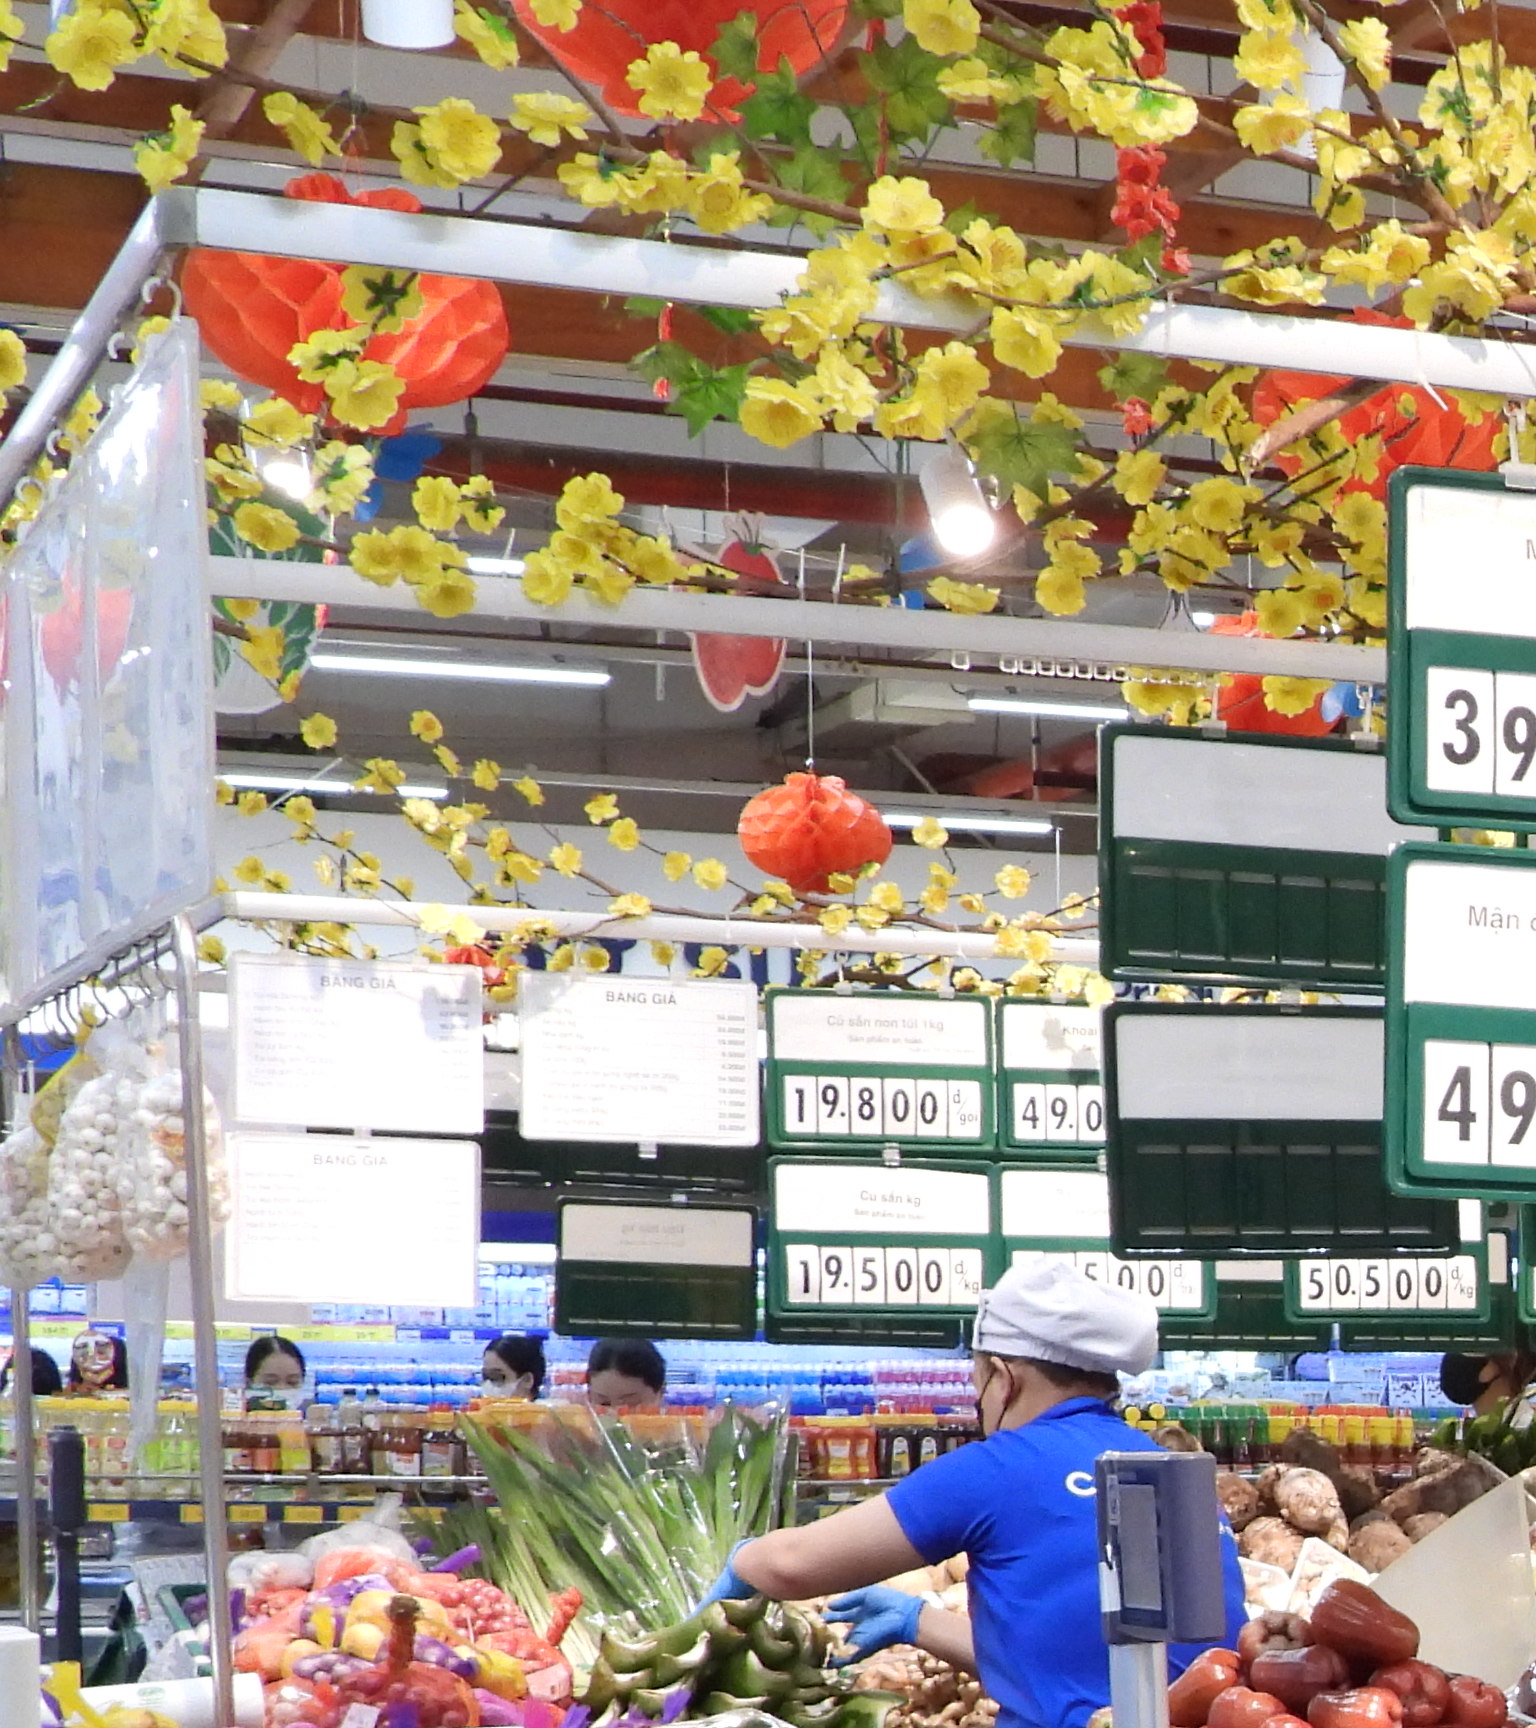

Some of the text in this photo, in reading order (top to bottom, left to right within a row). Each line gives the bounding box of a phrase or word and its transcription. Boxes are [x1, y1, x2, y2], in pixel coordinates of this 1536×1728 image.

[1468, 905, 1520, 935] Mận
[794, 1084, 938, 1123] 19.800
[800, 1255, 942, 1293] 19.500
[1308, 1266, 1442, 1299] 50.500
